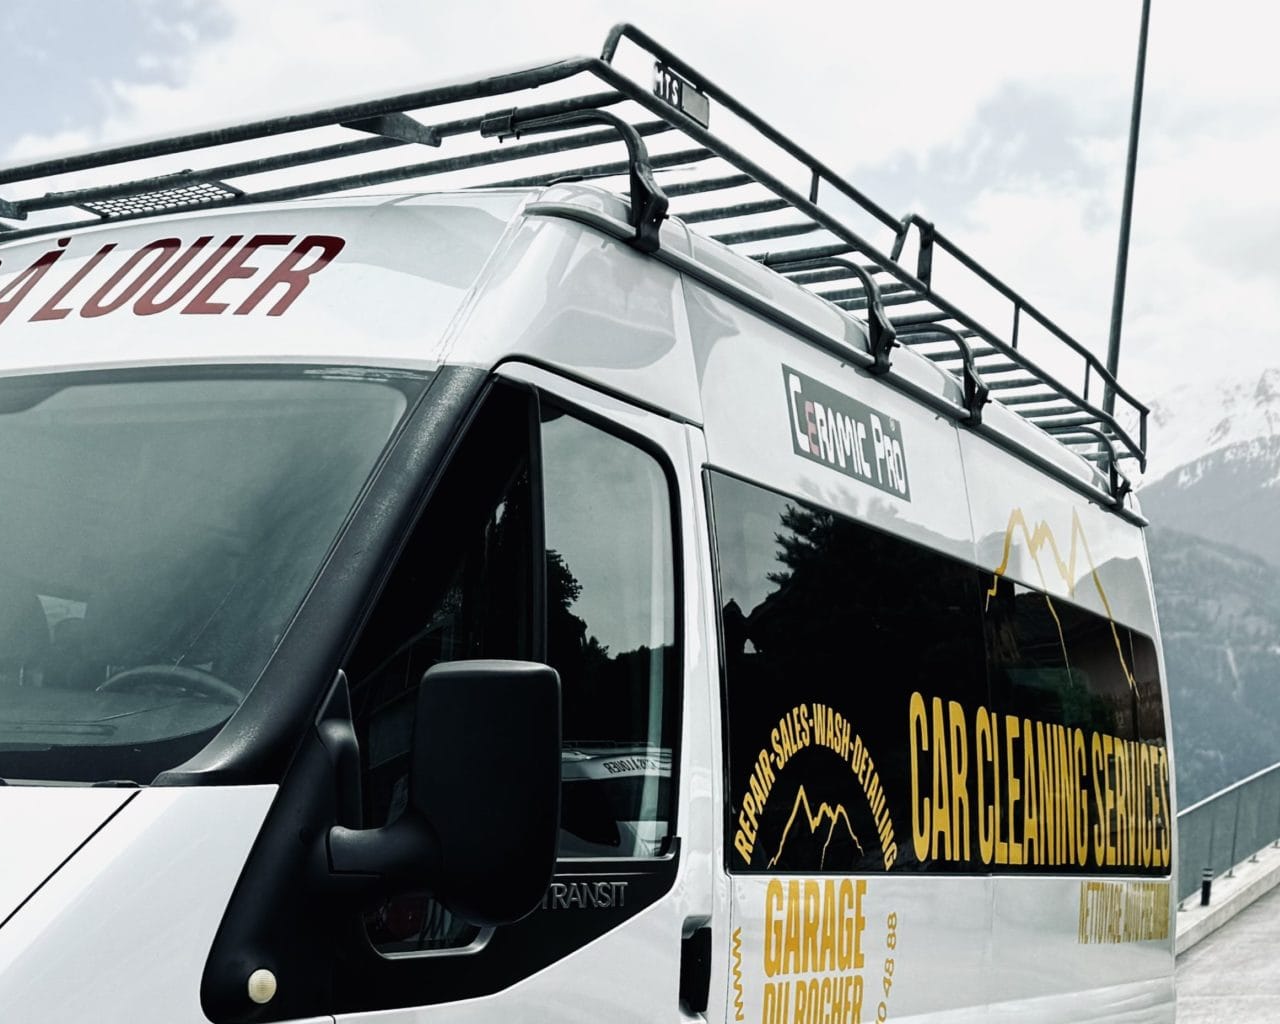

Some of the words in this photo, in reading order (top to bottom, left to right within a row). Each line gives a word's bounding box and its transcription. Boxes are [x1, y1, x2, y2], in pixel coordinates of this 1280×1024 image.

[28, 235, 346, 323] LOUER
[910, 692, 970, 862] CAR
[976, 706, 1088, 866] CLEANING
[1092, 731, 1170, 867] SERVICES
[764, 879, 867, 977] GARAGE
[887, 912, 897, 950] 88
[883, 958, 895, 998] 48
